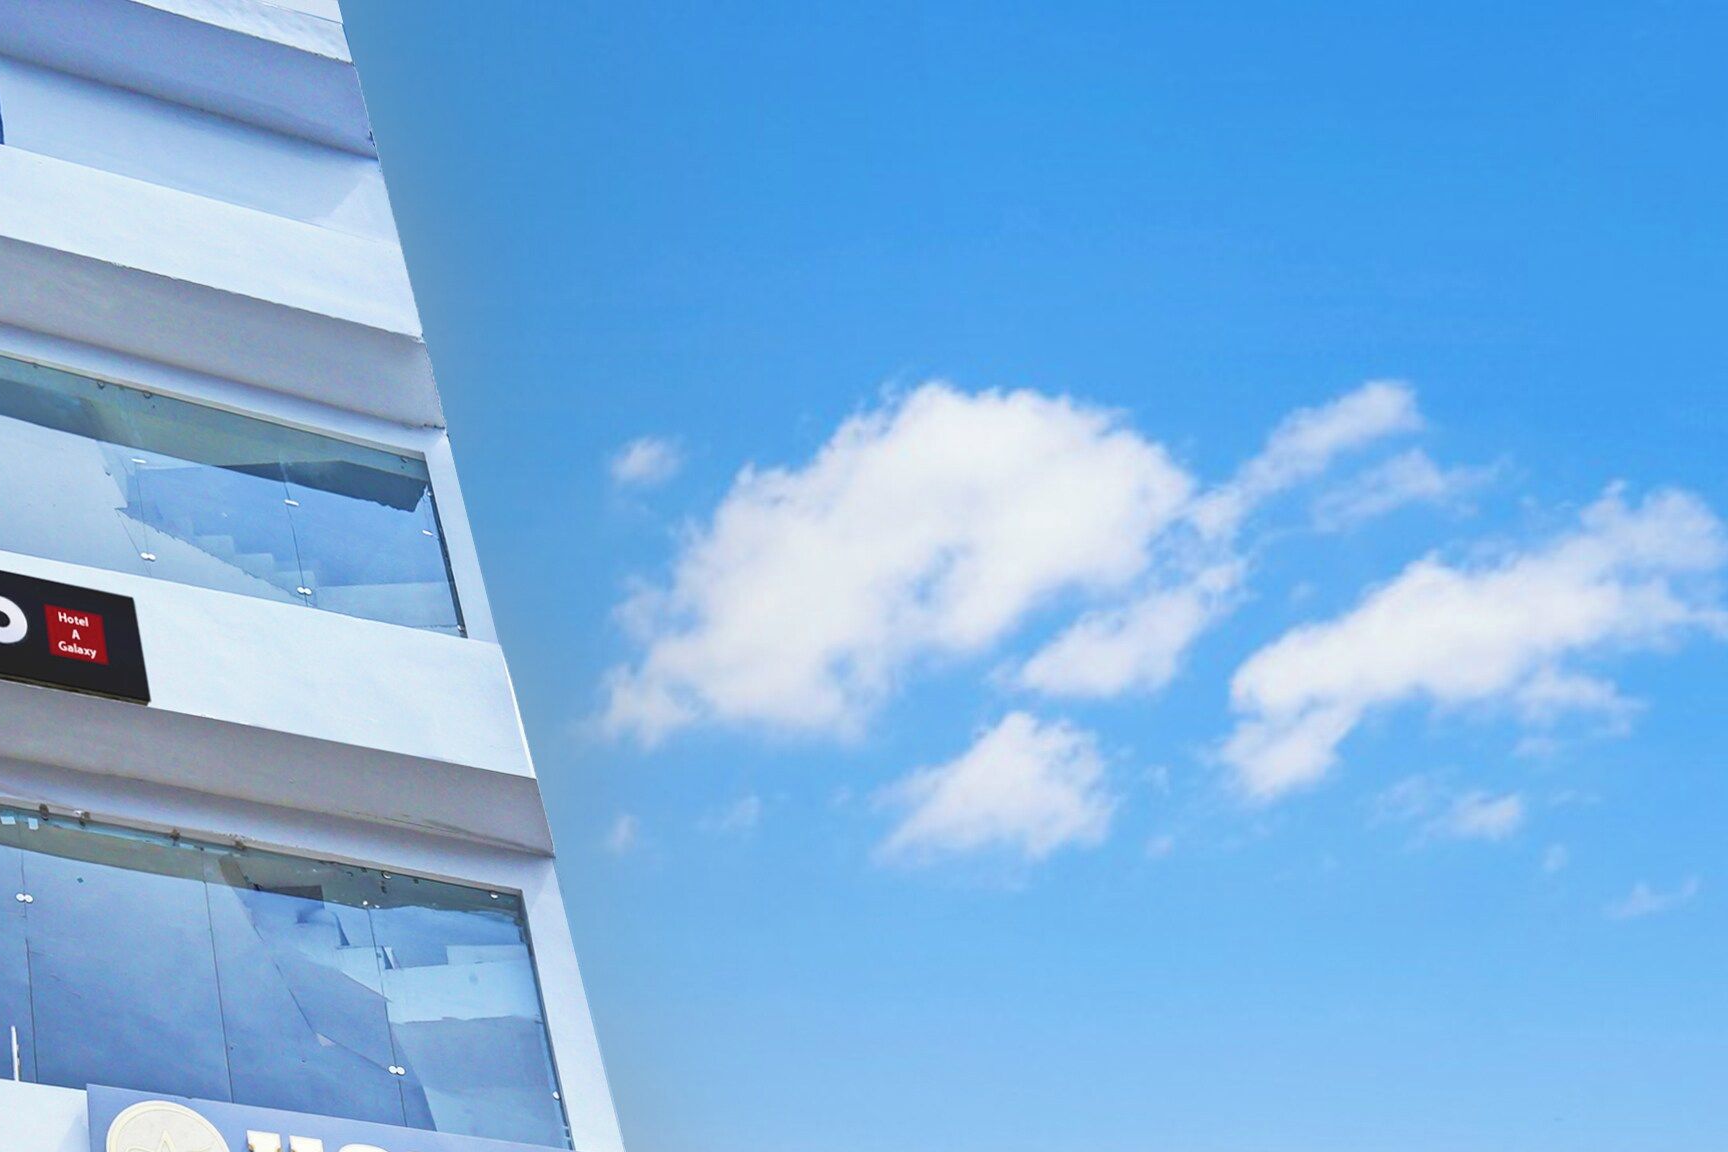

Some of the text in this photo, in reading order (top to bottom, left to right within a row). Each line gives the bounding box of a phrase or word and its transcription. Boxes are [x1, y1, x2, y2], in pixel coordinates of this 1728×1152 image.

[58, 611, 89, 627] Hotel
[71, 629, 81, 640] A
[58, 640, 97, 659] Galaxy
